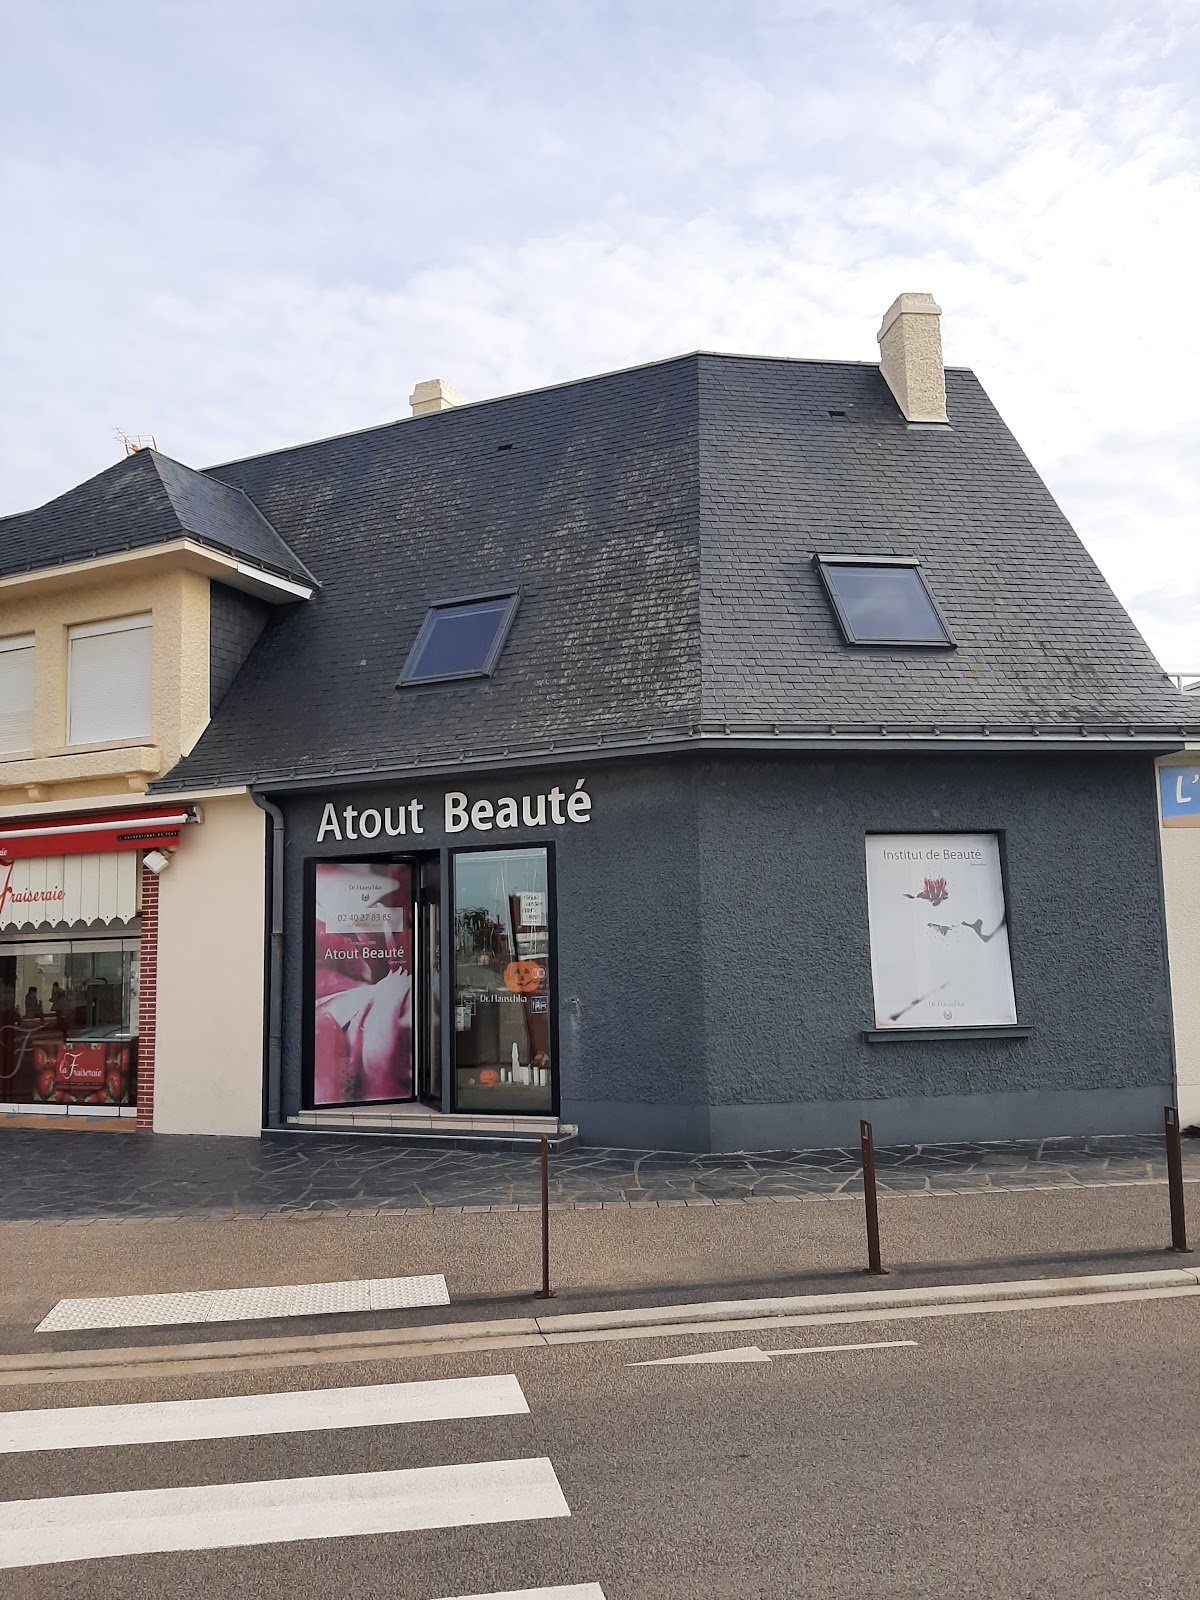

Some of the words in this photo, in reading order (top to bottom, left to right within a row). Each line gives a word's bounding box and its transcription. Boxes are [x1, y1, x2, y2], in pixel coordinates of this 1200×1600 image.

[316, 798, 424, 842] Atout
[444, 778, 592, 833] Beauté
[883, 849, 923, 860] Institut
[926, 849, 940, 860] de
[943, 848, 982, 860] Beauté
[337, 914, 347, 922] 02
[382, 913, 392, 921] 85
[324, 948, 359, 960] Atout
[362, 946, 404, 959] Beauté
[491, 994, 527, 1003] Hauschka
